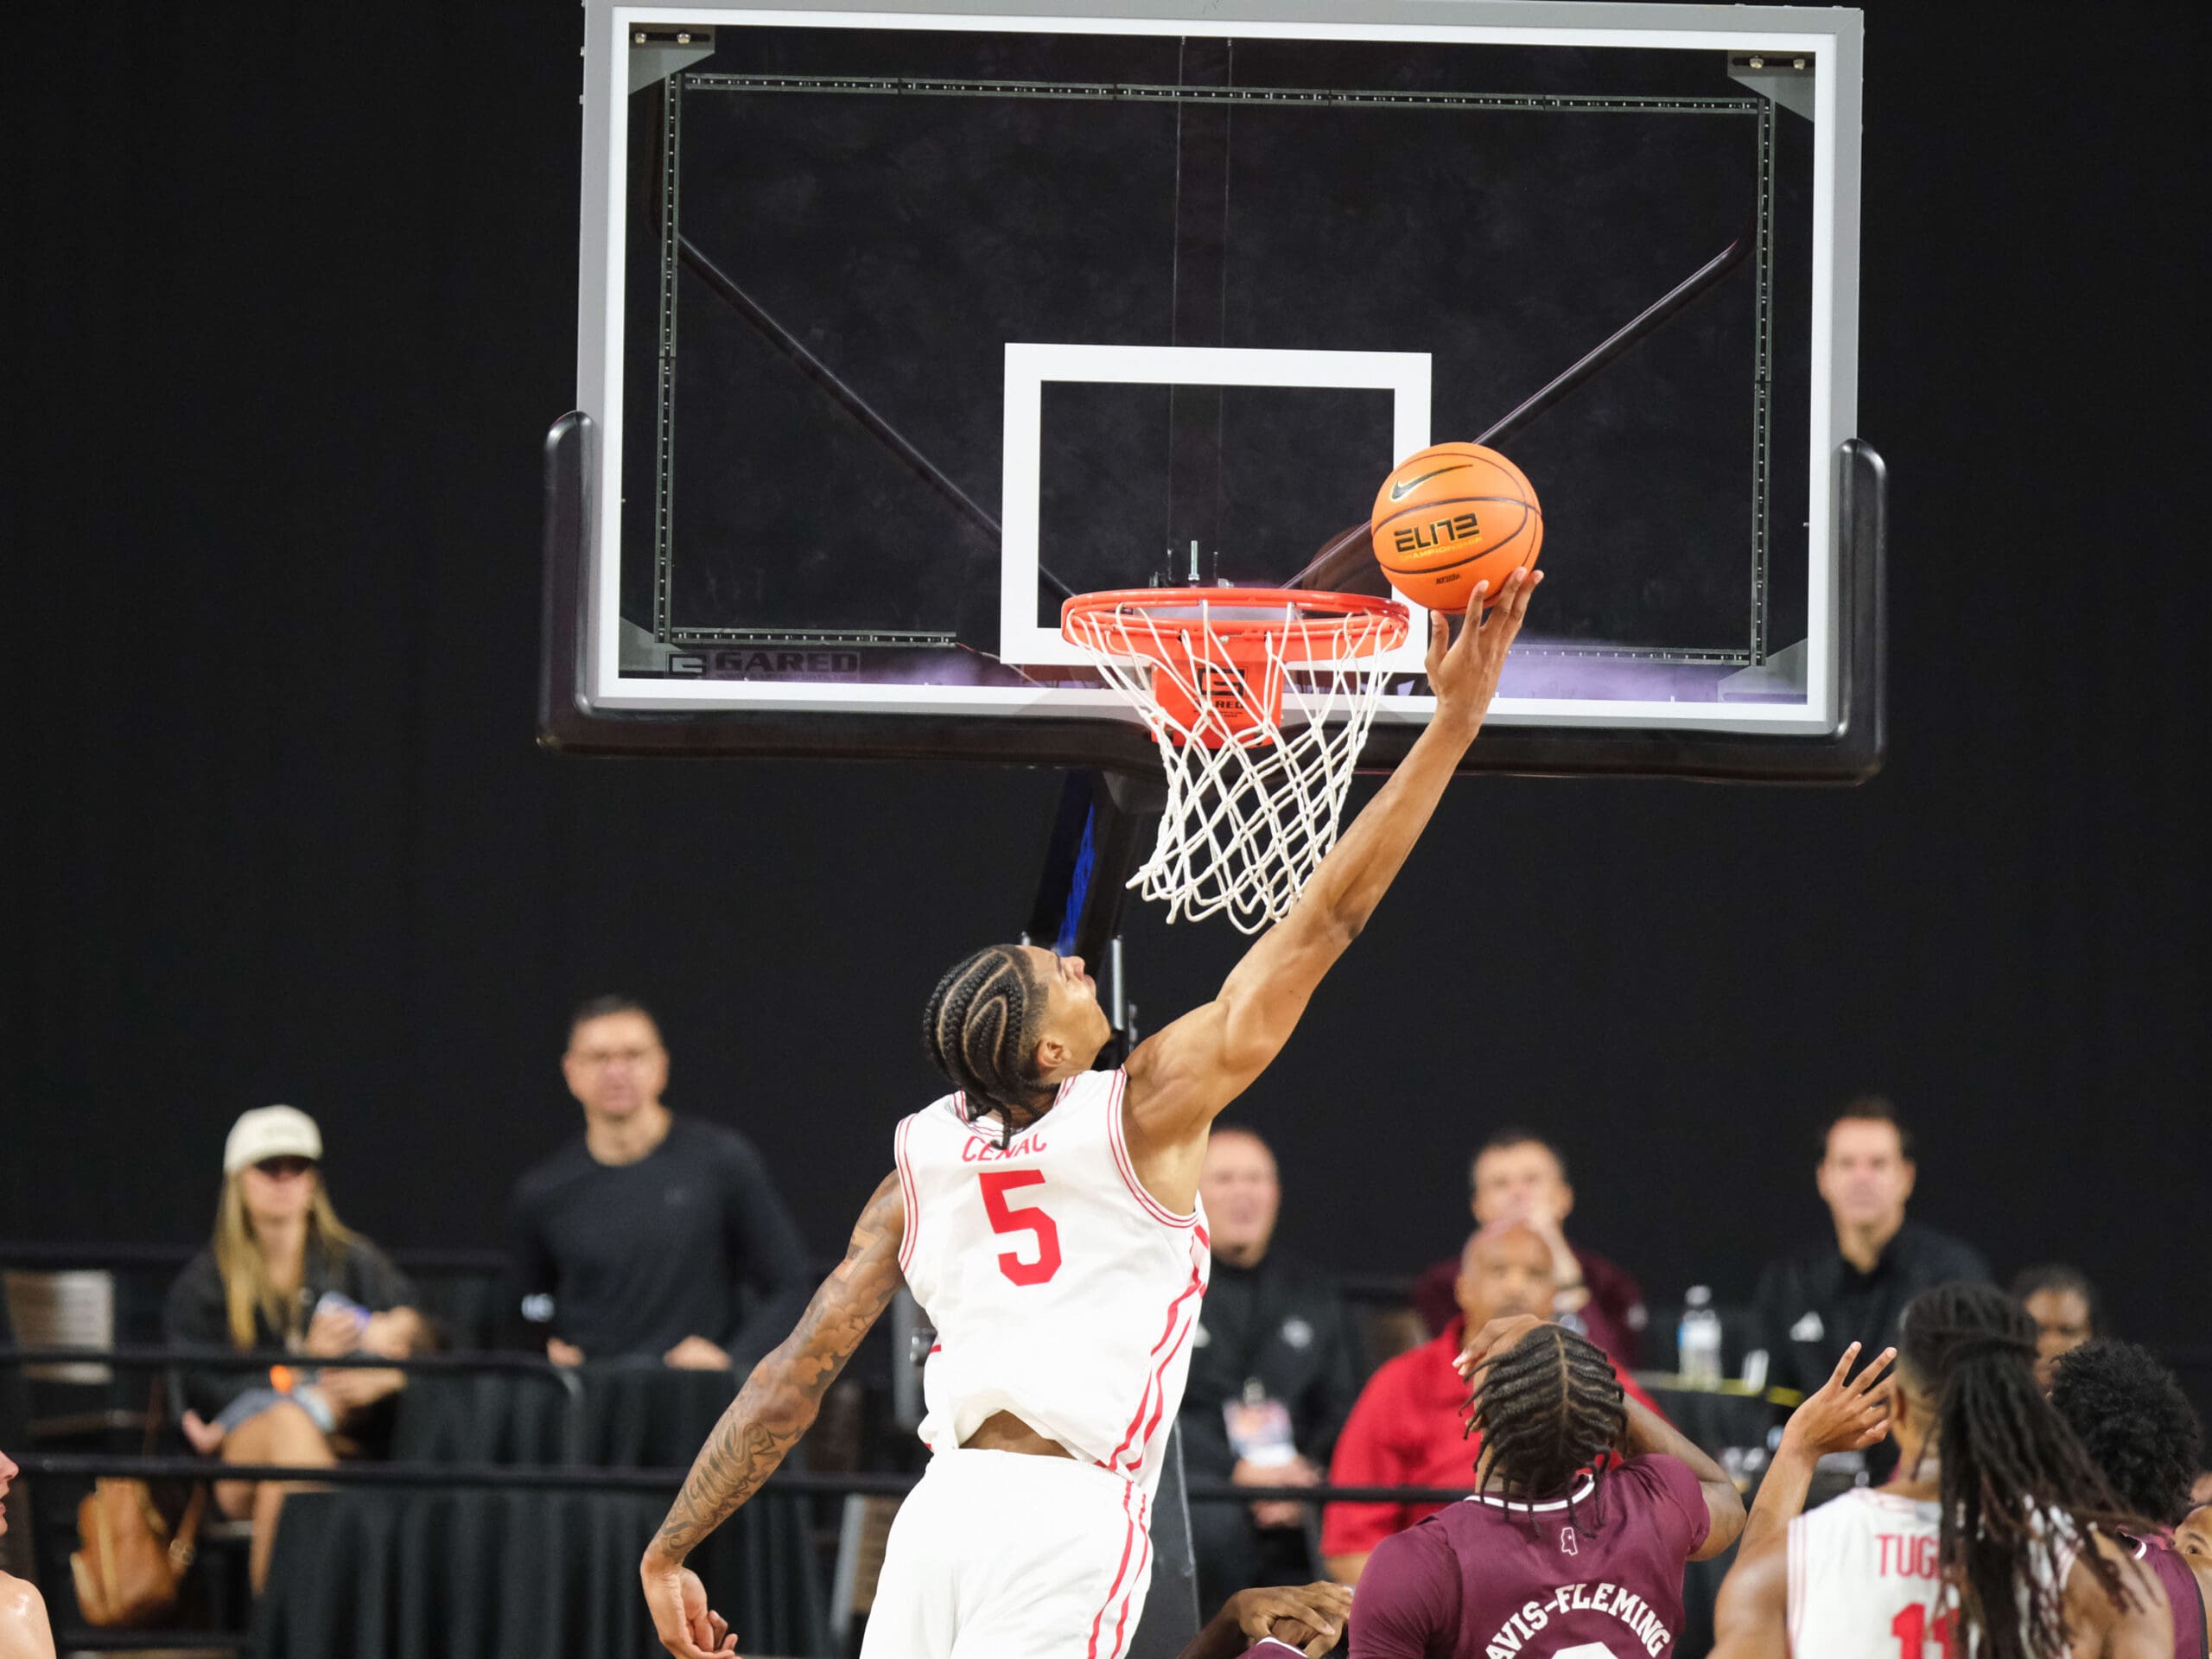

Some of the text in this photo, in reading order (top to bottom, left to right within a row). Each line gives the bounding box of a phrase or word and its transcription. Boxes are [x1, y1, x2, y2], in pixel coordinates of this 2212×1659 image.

[1394, 512, 1480, 553] ELITE
[1398, 537, 1483, 562] CHAMPIONSHIP
[715, 652, 858, 672] GARED
[962, 1134, 1047, 1162] CENAC
[978, 1169, 1062, 1287] 5
[1875, 1534, 1942, 1580] TUG
